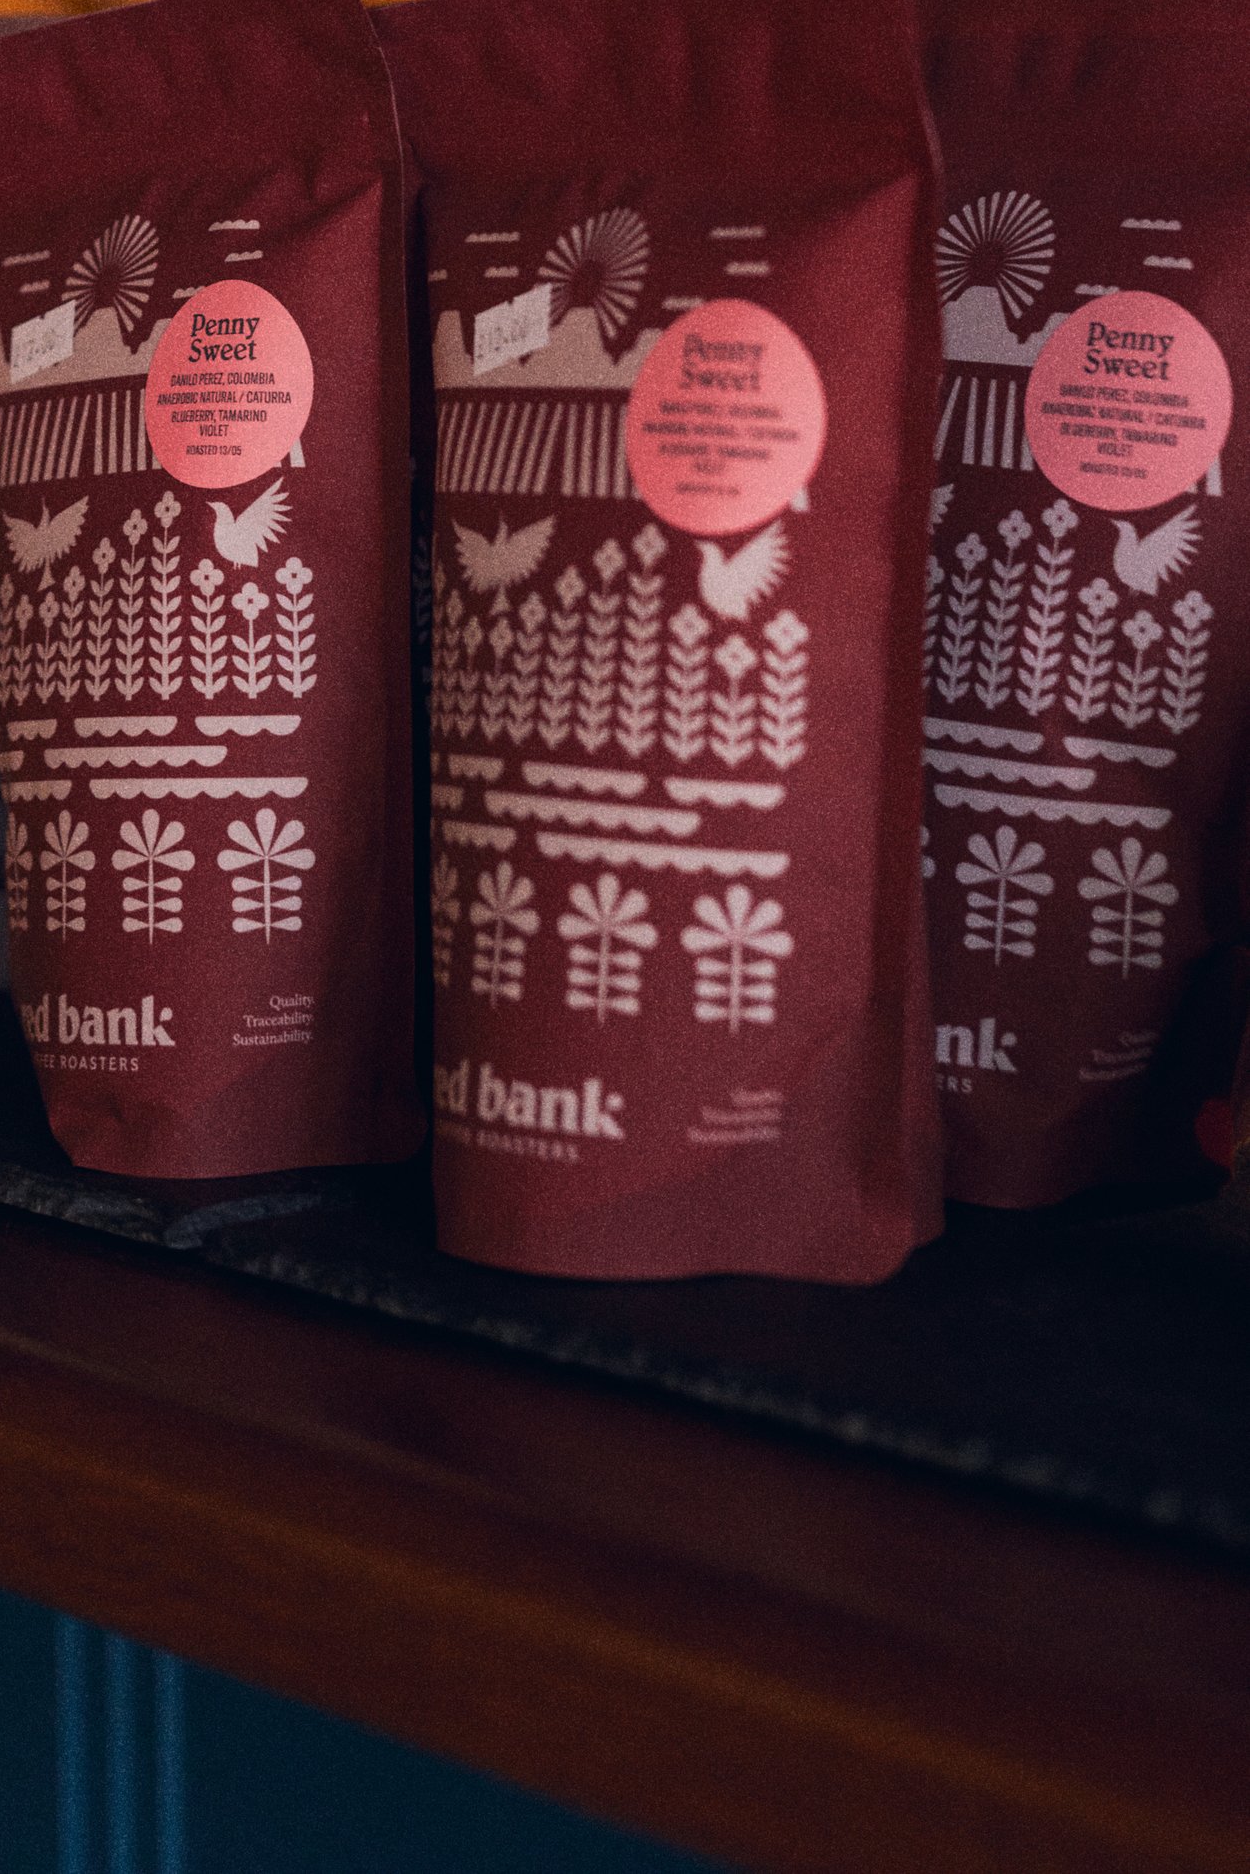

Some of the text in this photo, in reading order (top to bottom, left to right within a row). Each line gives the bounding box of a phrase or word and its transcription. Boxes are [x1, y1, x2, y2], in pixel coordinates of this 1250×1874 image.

[190, 313, 260, 340] Penny
[1086, 321, 1174, 358] Penny
[188, 338, 257, 363] Sweet
[1082, 348, 1171, 381] Sweet
[199, 372, 225, 386] PEREZ,
[227, 372, 275, 385] COLOMBIA
[200, 391, 237, 404] NATURAL
[246, 391, 292, 404] CATURRA
[171, 410, 216, 424] BLUEBERRY,
[199, 424, 229, 437] VIOLET
[186, 445, 218, 456] ROASTED
[58, 993, 176, 1047] bank
[59, 1054, 140, 1072] ROASTERS
[477, 1062, 625, 1140] bank
